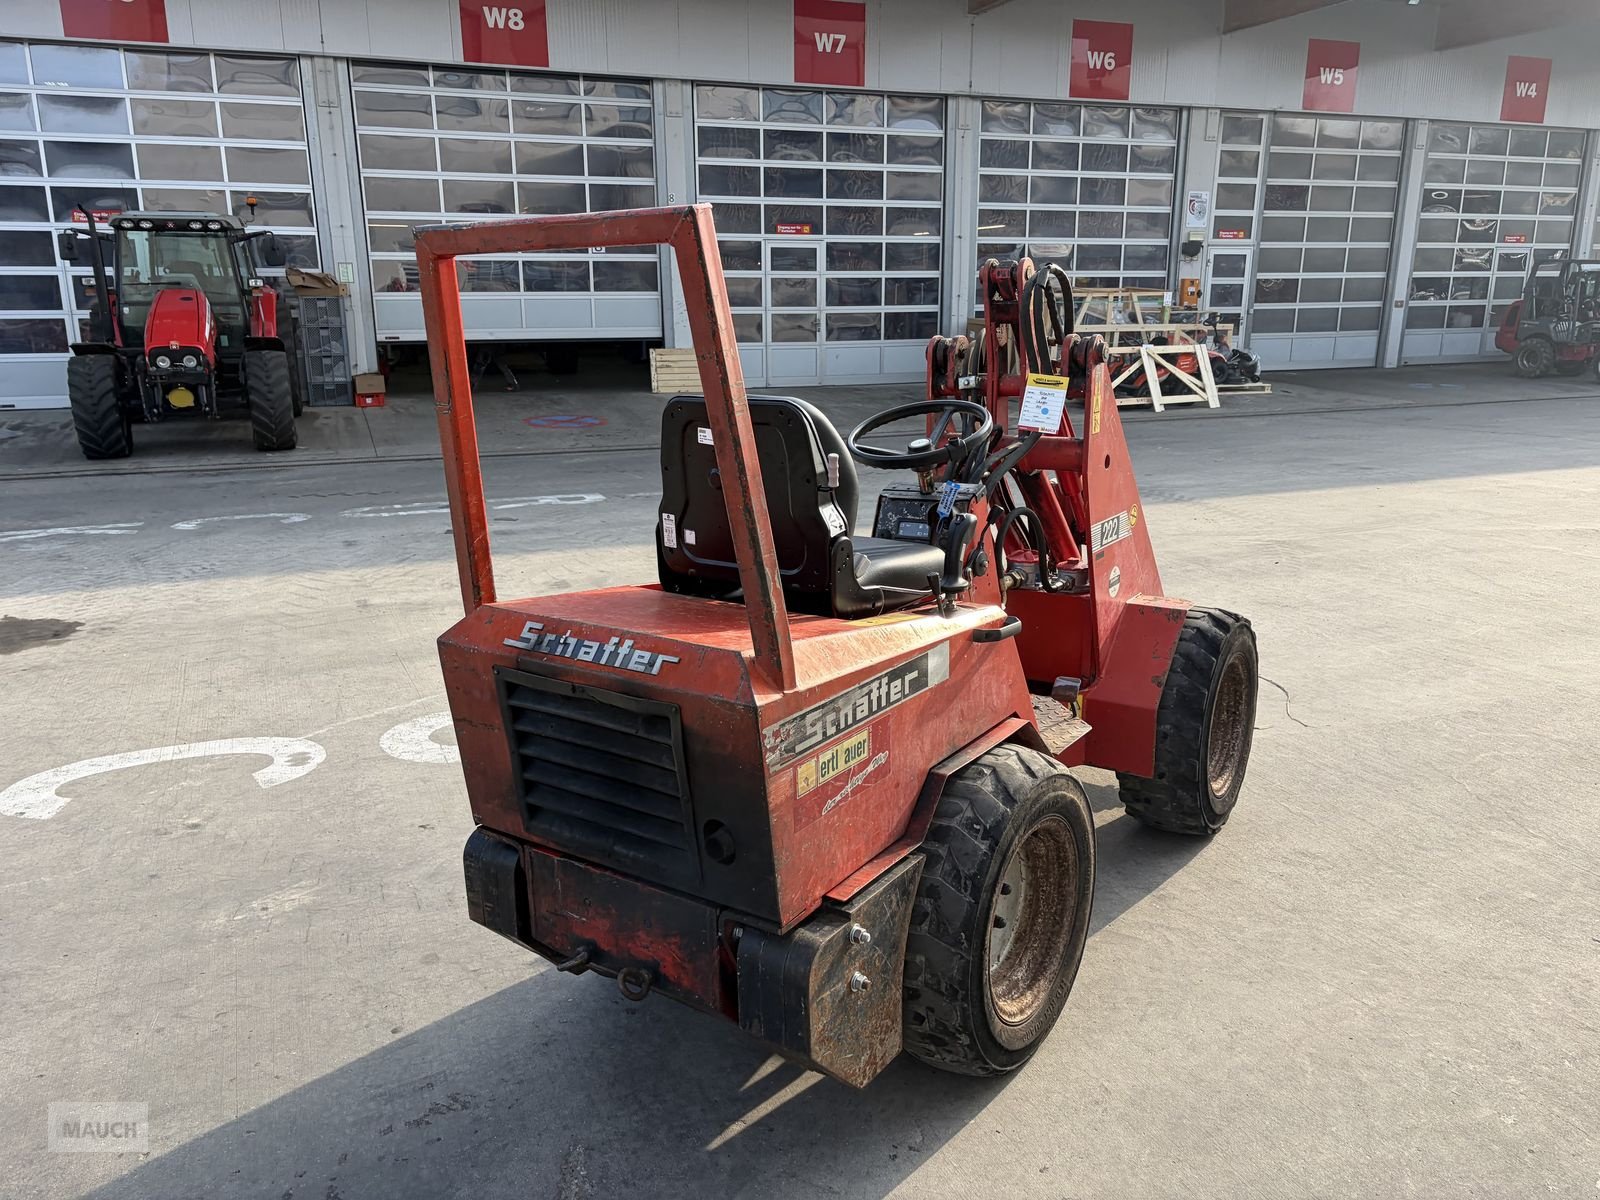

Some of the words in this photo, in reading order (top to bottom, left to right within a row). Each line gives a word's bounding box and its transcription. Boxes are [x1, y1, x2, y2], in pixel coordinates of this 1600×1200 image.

[482, 6, 524, 30] W8
[814, 32, 846, 53] W7
[1088, 51, 1115, 70] W6
[1320, 67, 1343, 85] W5
[1516, 81, 1536, 98] W4
[668, 193, 675, 203] 8
[1102, 517, 1119, 546] 222
[820, 749, 839, 779] ertl
[844, 738, 867, 765] auer
